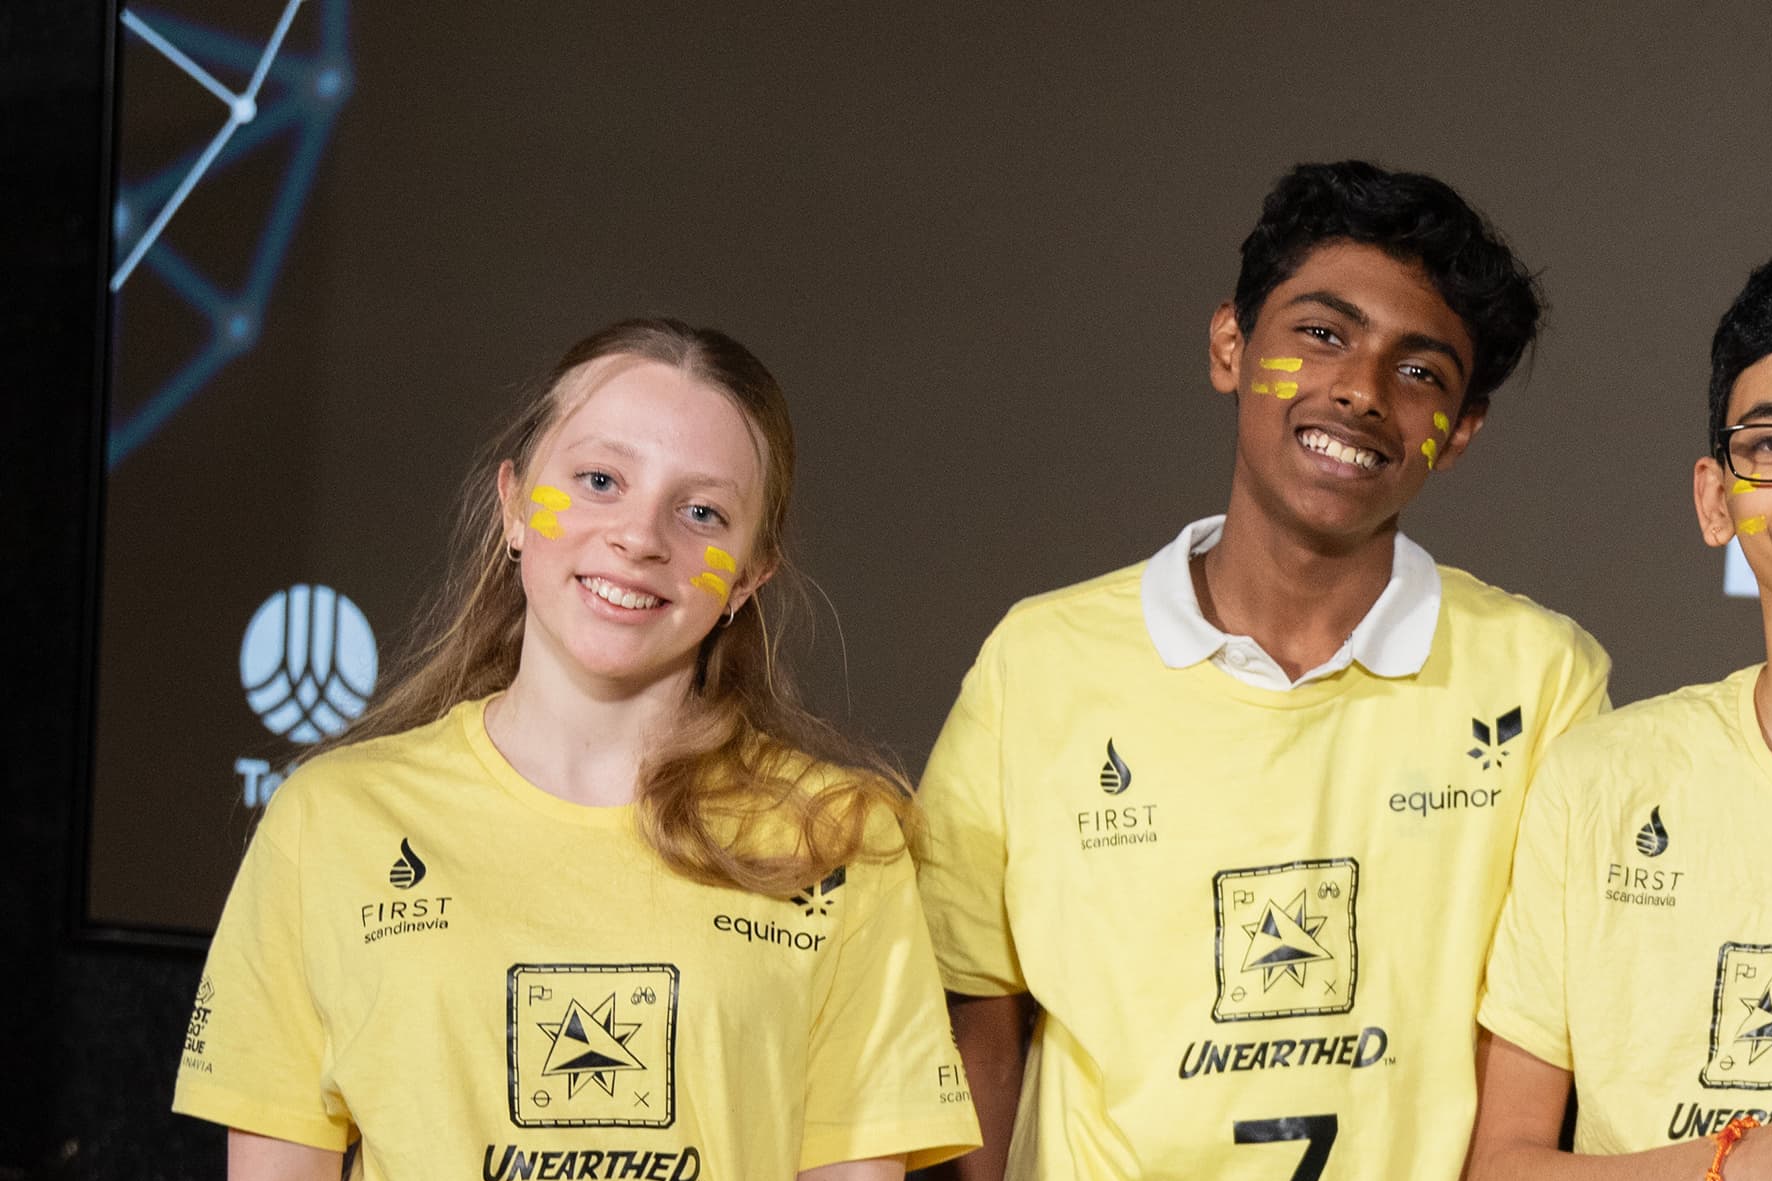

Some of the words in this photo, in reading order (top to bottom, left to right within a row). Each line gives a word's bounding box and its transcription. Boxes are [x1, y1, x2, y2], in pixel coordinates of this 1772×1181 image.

[1388, 784, 1503, 817] equinor
[1077, 804, 1158, 833] FIRST
[1081, 830, 1157, 850] scandinavia
[1607, 863, 1685, 891] FIRST
[1604, 888, 1677, 907] scandinavia
[361, 897, 453, 928] FIRST
[364, 918, 449, 944] scandinavia
[713, 914, 826, 952] equinor
